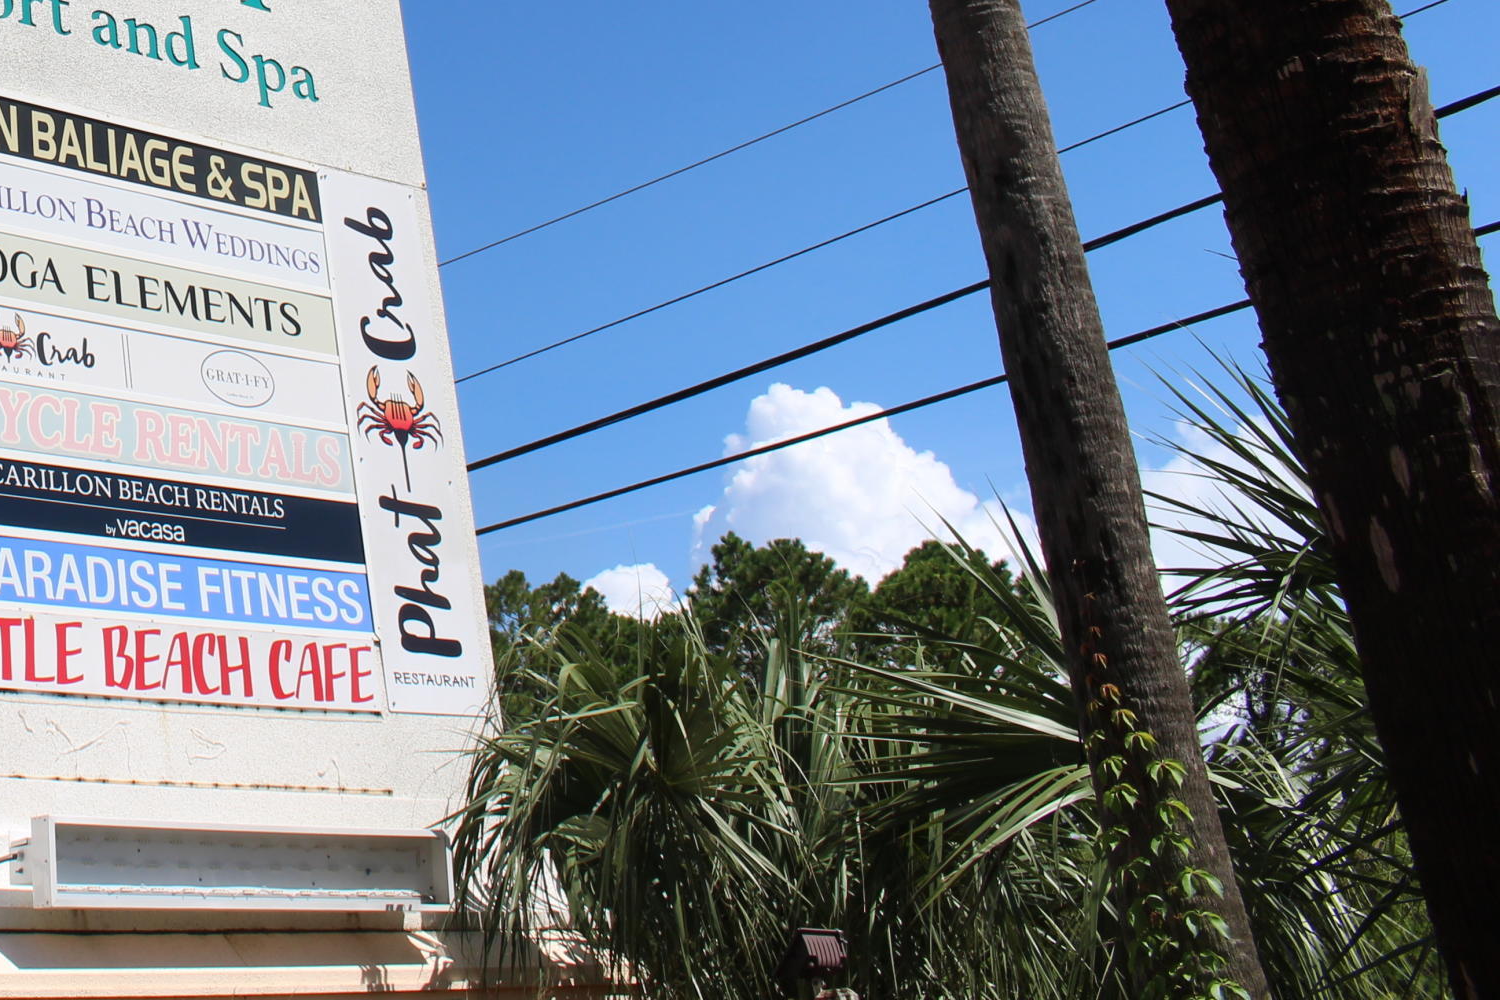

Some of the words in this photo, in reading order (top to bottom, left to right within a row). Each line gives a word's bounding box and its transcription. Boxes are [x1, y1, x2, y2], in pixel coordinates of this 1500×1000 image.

[91, 9, 200, 71] and
[218, 28, 319, 108] Spa
[30, 110, 197, 194] BALIAGE
[206, 155, 238, 202] &
[240, 161, 317, 220] SPA
[82, 264, 302, 338] ELEMENTS
[343, 206, 417, 361] Crab
[36, 332, 96, 369] Crab
[133, 407, 344, 487] RENTALS
[105, 523, 117, 537] by
[118, 478, 191, 508] BEACH
[195, 488, 286, 519] RENTALS
[199, 567, 365, 626] FITNESS
[378, 483, 463, 658] Phat
[101, 624, 254, 698] BEACH
[268, 639, 374, 704] CAFE
[393, 671, 476, 690] RESTAURANT
